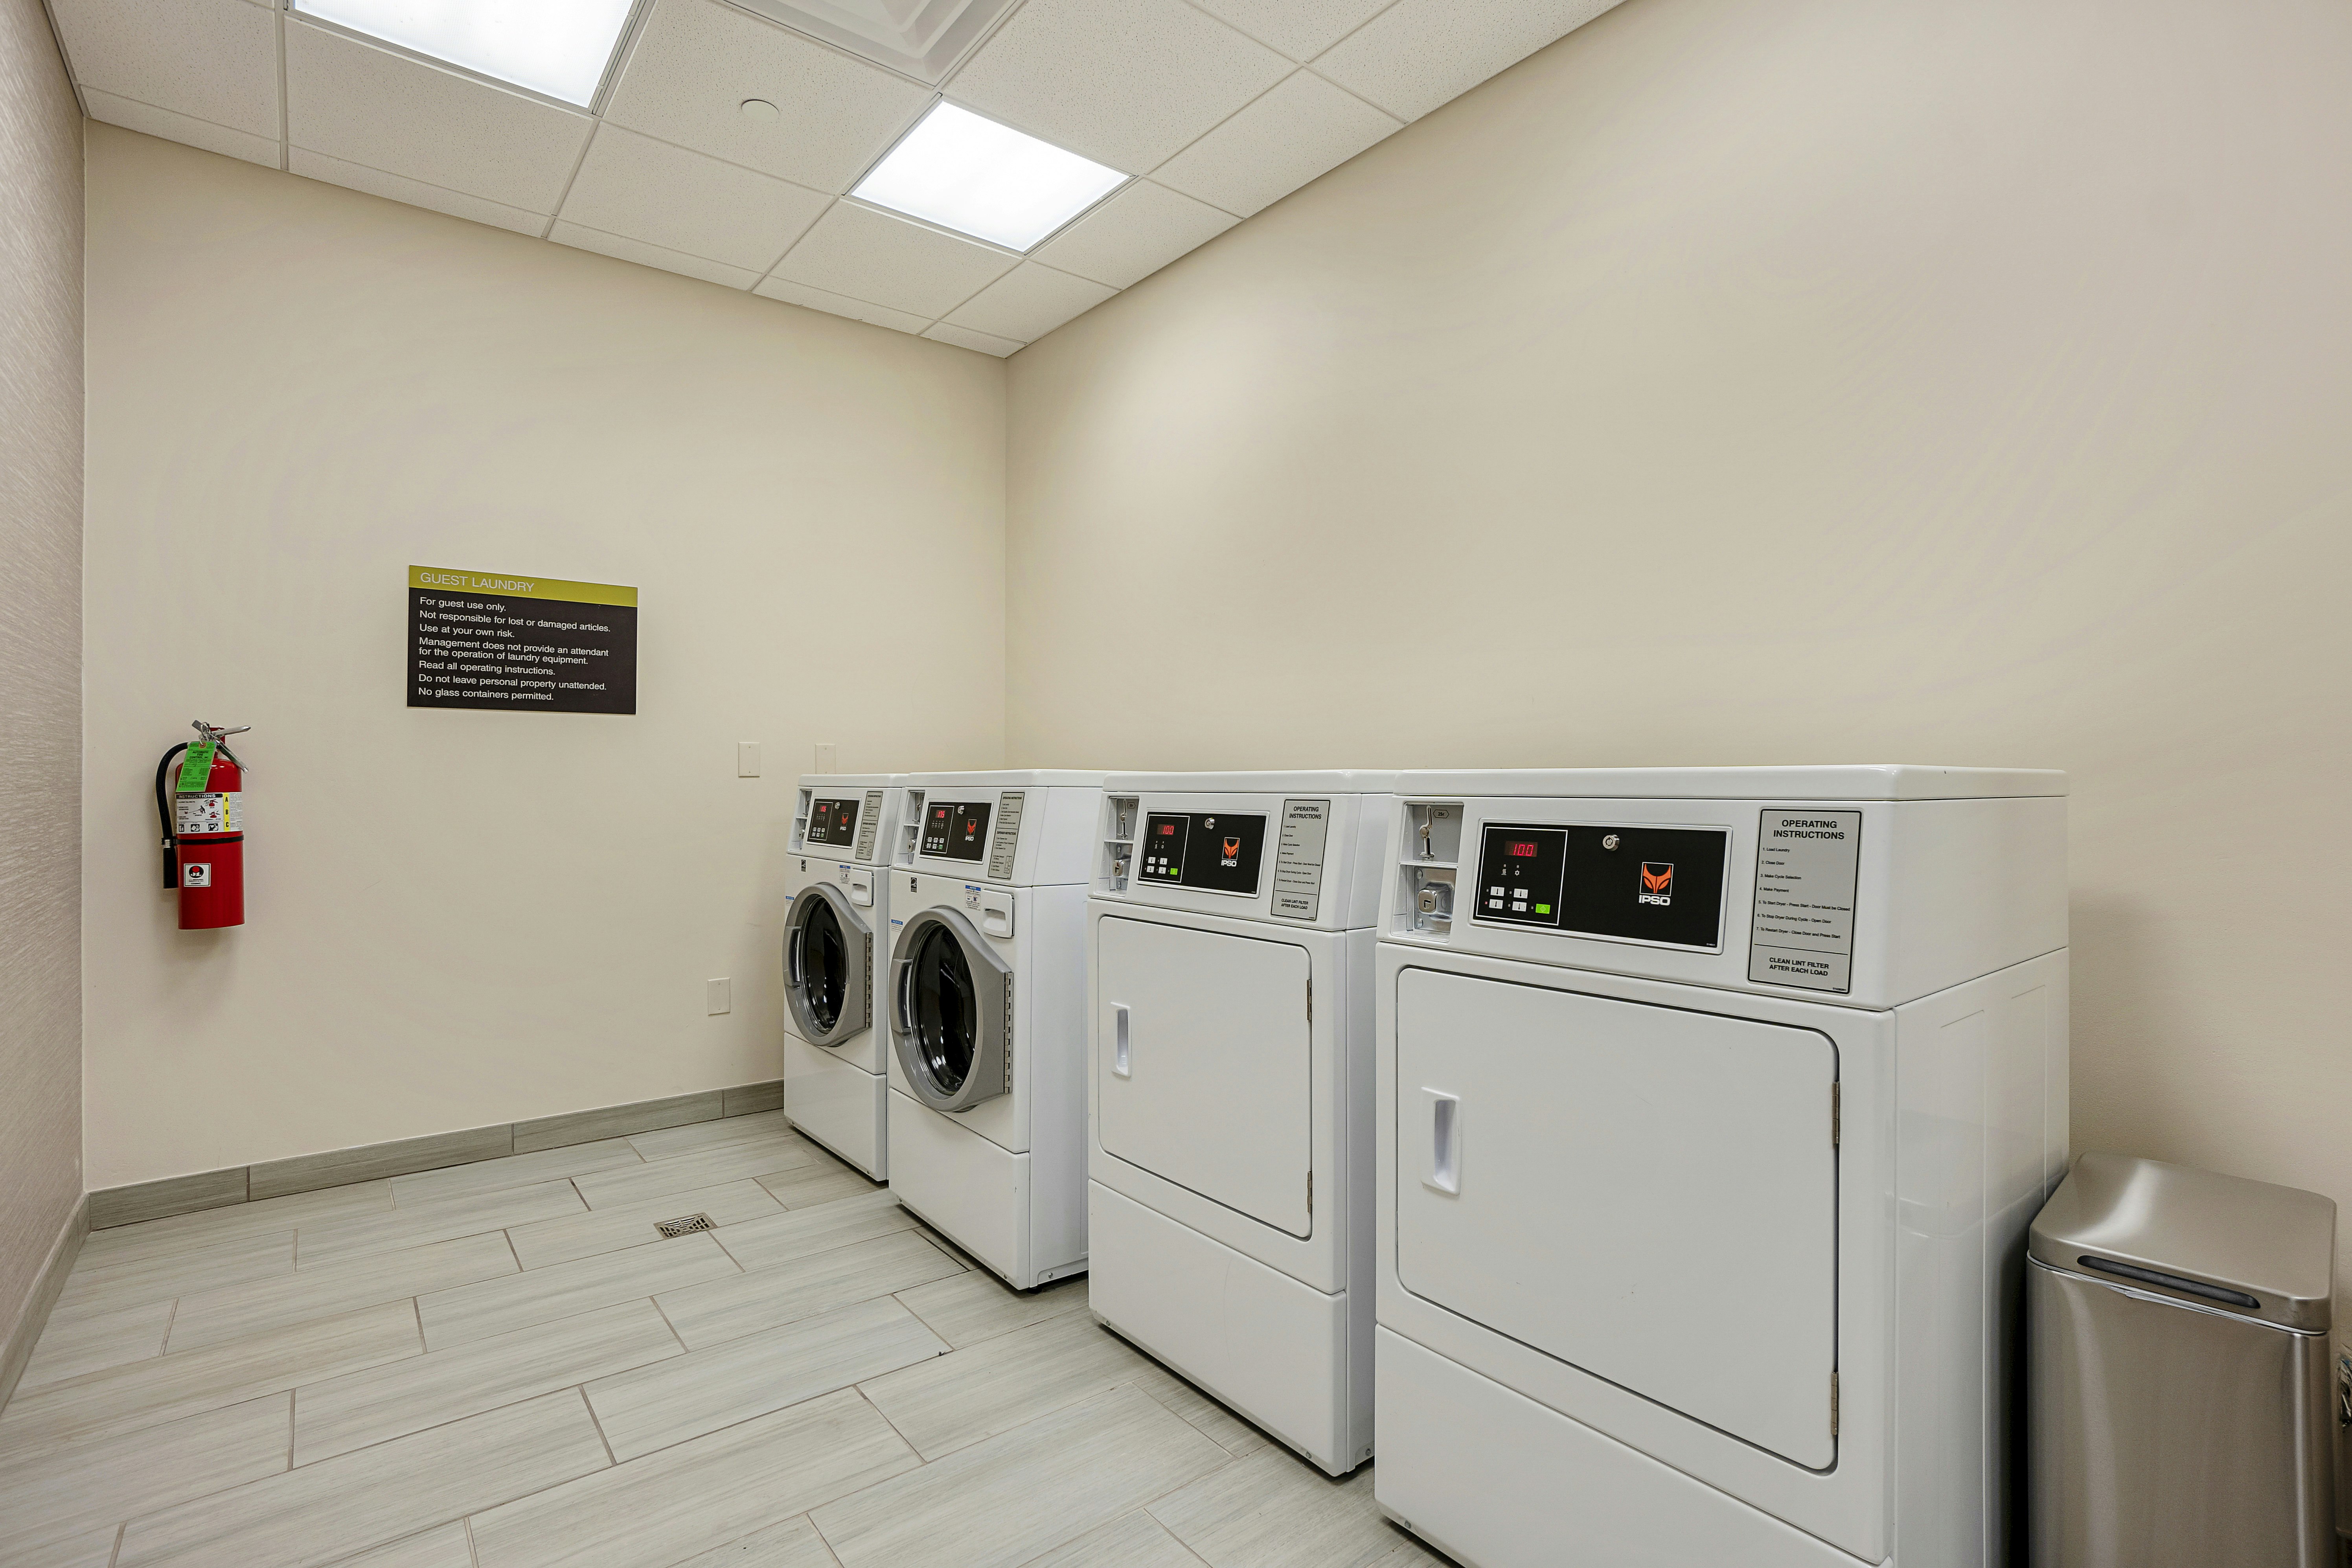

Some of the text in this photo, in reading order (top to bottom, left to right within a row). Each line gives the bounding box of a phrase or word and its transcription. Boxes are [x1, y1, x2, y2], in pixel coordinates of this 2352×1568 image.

[420, 572, 534, 592] GUEST LAUNDRY
[420, 597, 436, 605] For
[486, 603, 506, 612] only.
[420, 610, 436, 619] Not
[439, 613, 491, 623] responsible
[494, 616, 506, 624] for
[508, 617, 524, 625] lost
[537, 619, 577, 630] damaged
[579, 623, 611, 632] articles.
[419, 623, 438, 632] Use
[497, 629, 515, 638] risk.
[419, 637, 480, 648] Management
[482, 641, 504, 650] does
[524, 645, 555, 653] provide
[570, 647, 609, 656] attendant
[418, 647, 432, 655] for
[434, 648, 449, 656] the
[452, 651, 494, 659] operation
[508, 652, 540, 663] laundry
[542, 655, 588, 664] equipment.
[419, 660, 444, 669] Read
[460, 664, 502, 674] operating
[505, 665, 555, 675] instructions.
[419, 674, 432, 682] Do
[453, 675, 477, 684] leave
[520, 680, 556, 689] property
[559, 682, 607, 690] unattended.
[418, 687, 432, 695] No
[435, 688, 460, 698] glass
[462, 690, 509, 699] containers
[1163, 825, 1174, 834] 100
[1782, 819, 1837, 829] OPERATING
[1773, 830, 1844, 840] INSTRUCTIONS
[1513, 844, 1534, 856] 100
[1638, 895, 1670, 906] IPSO
